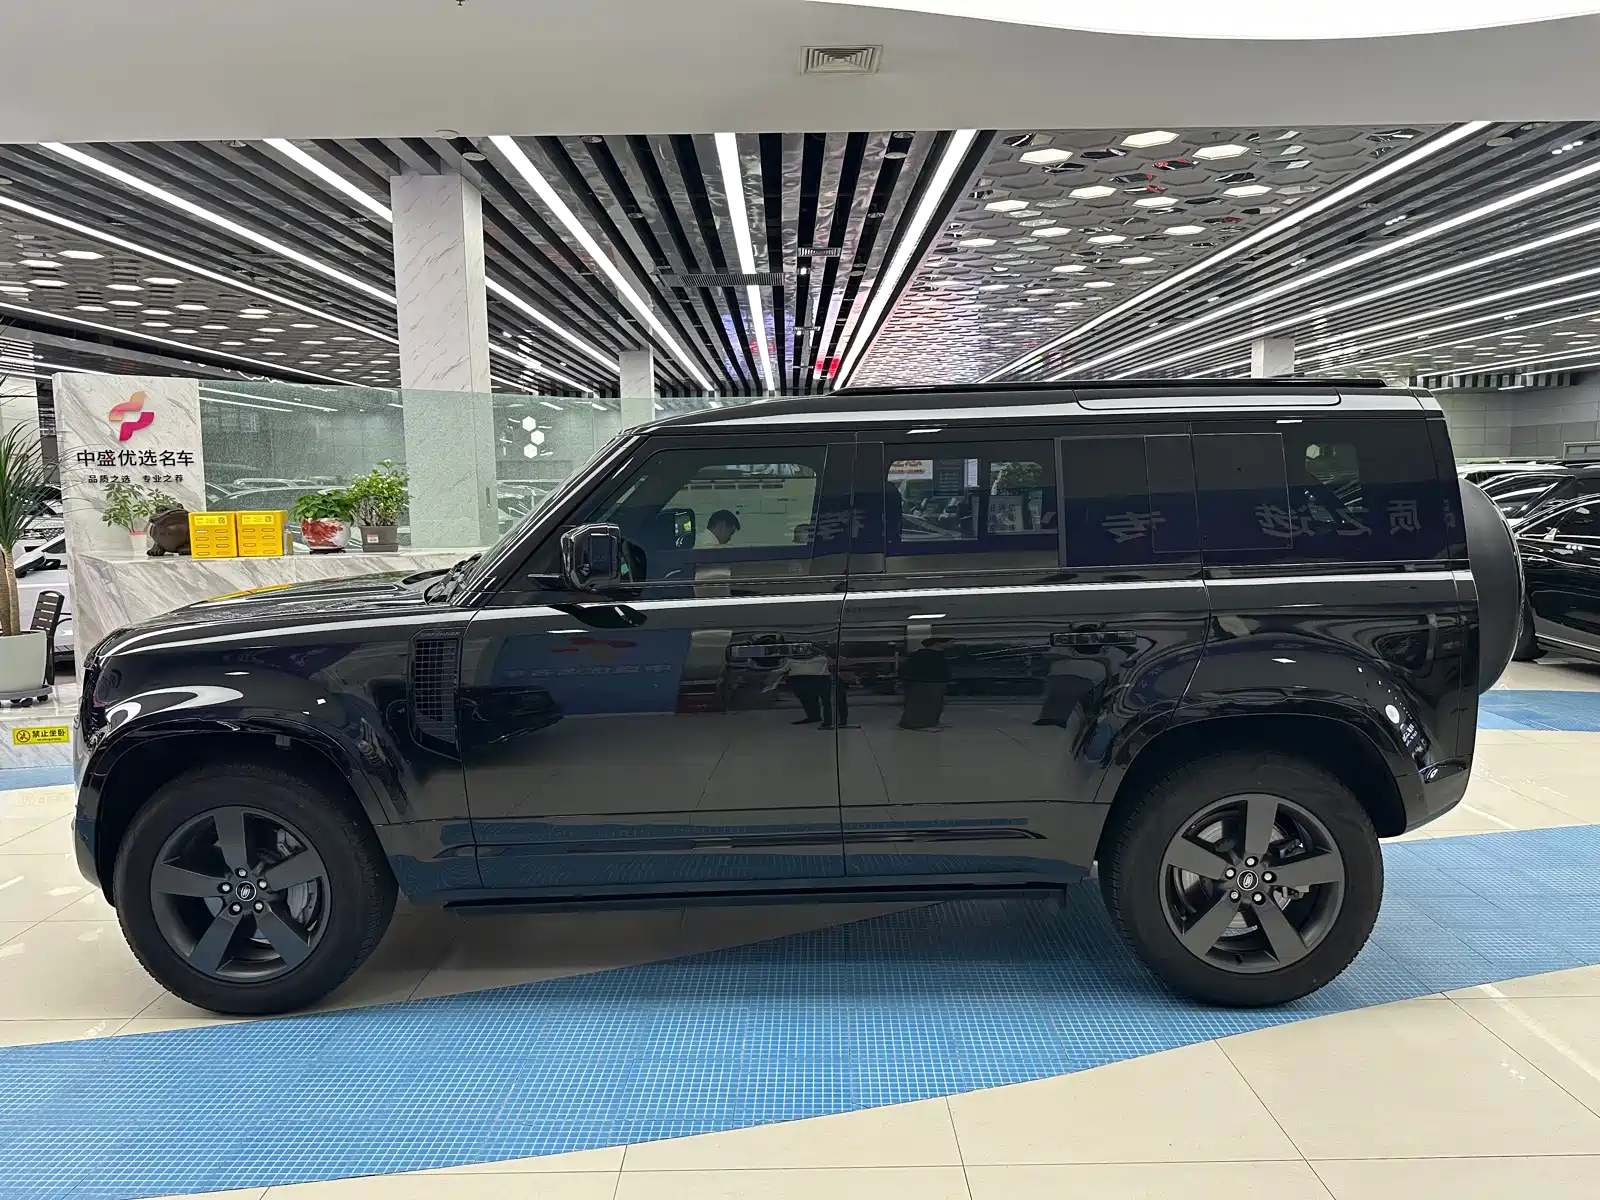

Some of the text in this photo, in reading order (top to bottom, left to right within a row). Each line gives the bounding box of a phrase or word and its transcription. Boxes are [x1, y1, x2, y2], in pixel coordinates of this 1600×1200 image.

[76, 449, 195, 467] 中盛优选名车
[88, 474, 185, 484] 品质之选 专业之荐
[32, 728, 66, 738] 禁止坐卧
